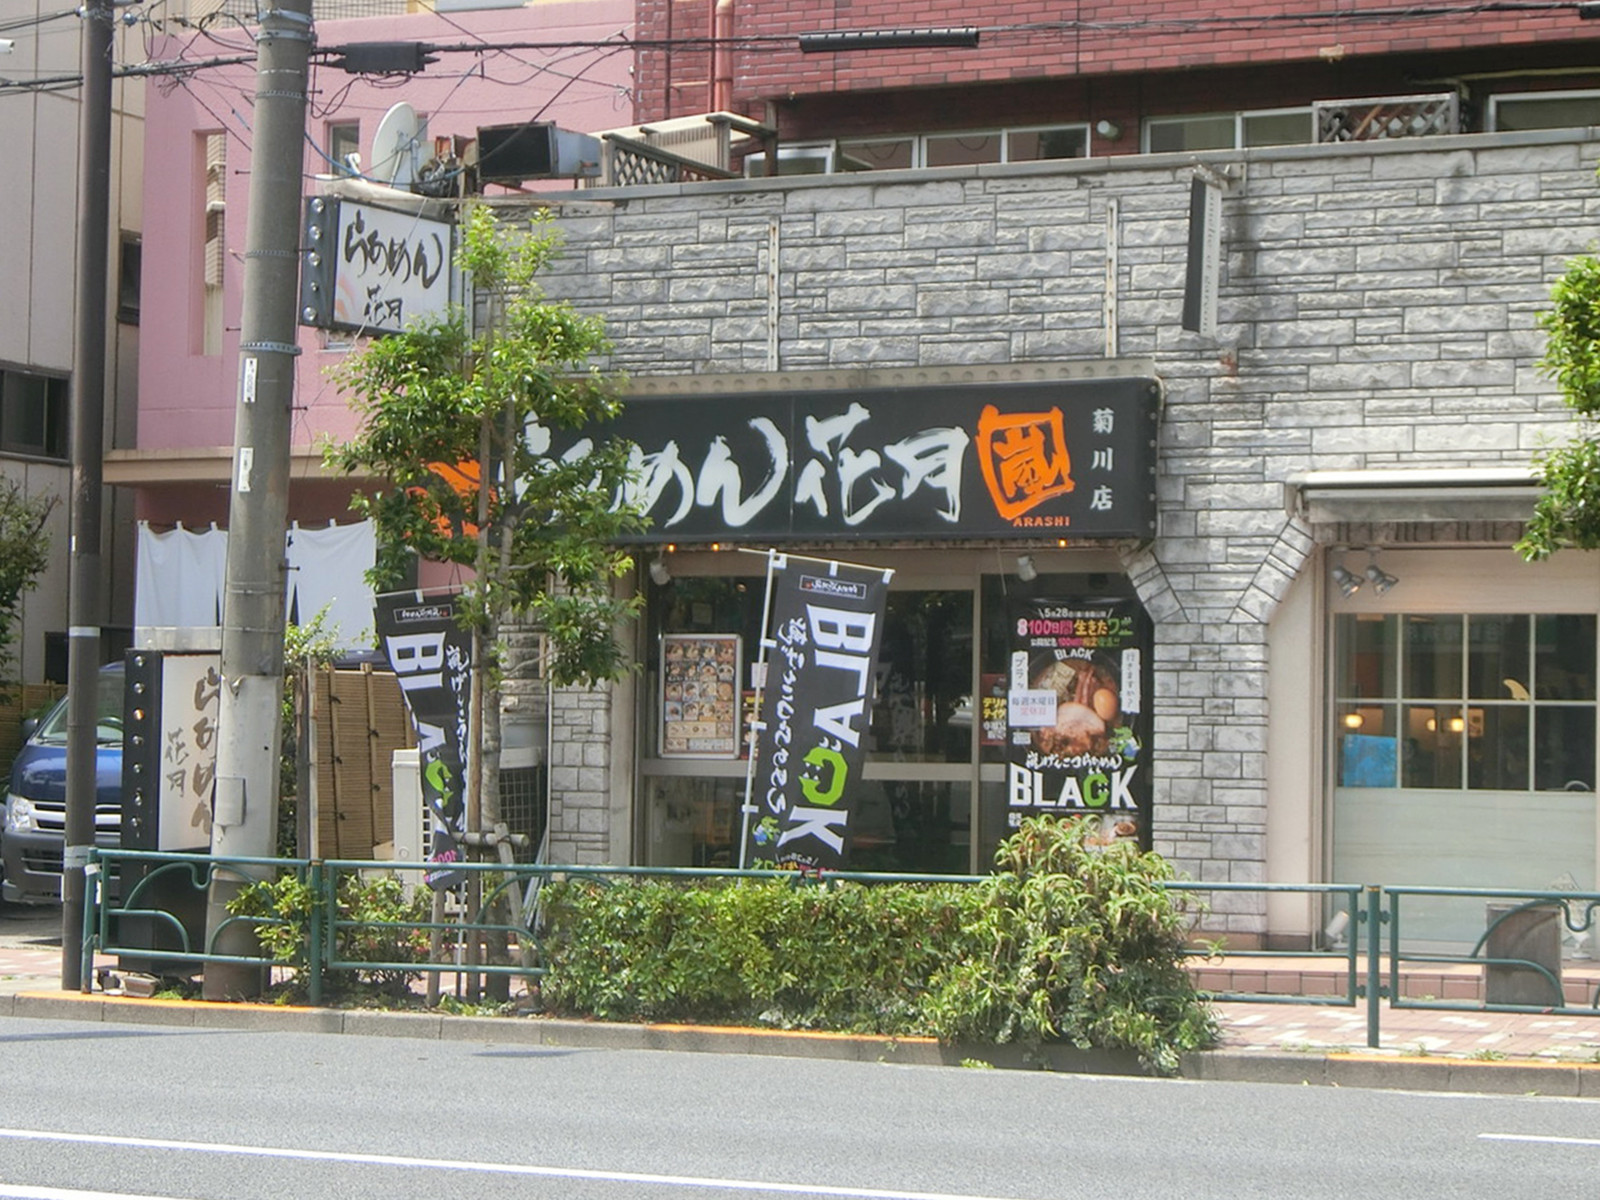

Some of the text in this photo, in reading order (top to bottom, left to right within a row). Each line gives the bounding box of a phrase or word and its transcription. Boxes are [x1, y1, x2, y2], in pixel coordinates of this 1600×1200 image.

[364, 284, 404, 329] 花月
[1090, 407, 1115, 511] 菊川店
[1013, 516, 1071, 528] ARASHI
[1054, 647, 1095, 661] BLACK
[1011, 696, 1055, 706] 毎週木曜日
[165, 727, 190, 798] 花月
[1009, 762, 1139, 809] BLACK
